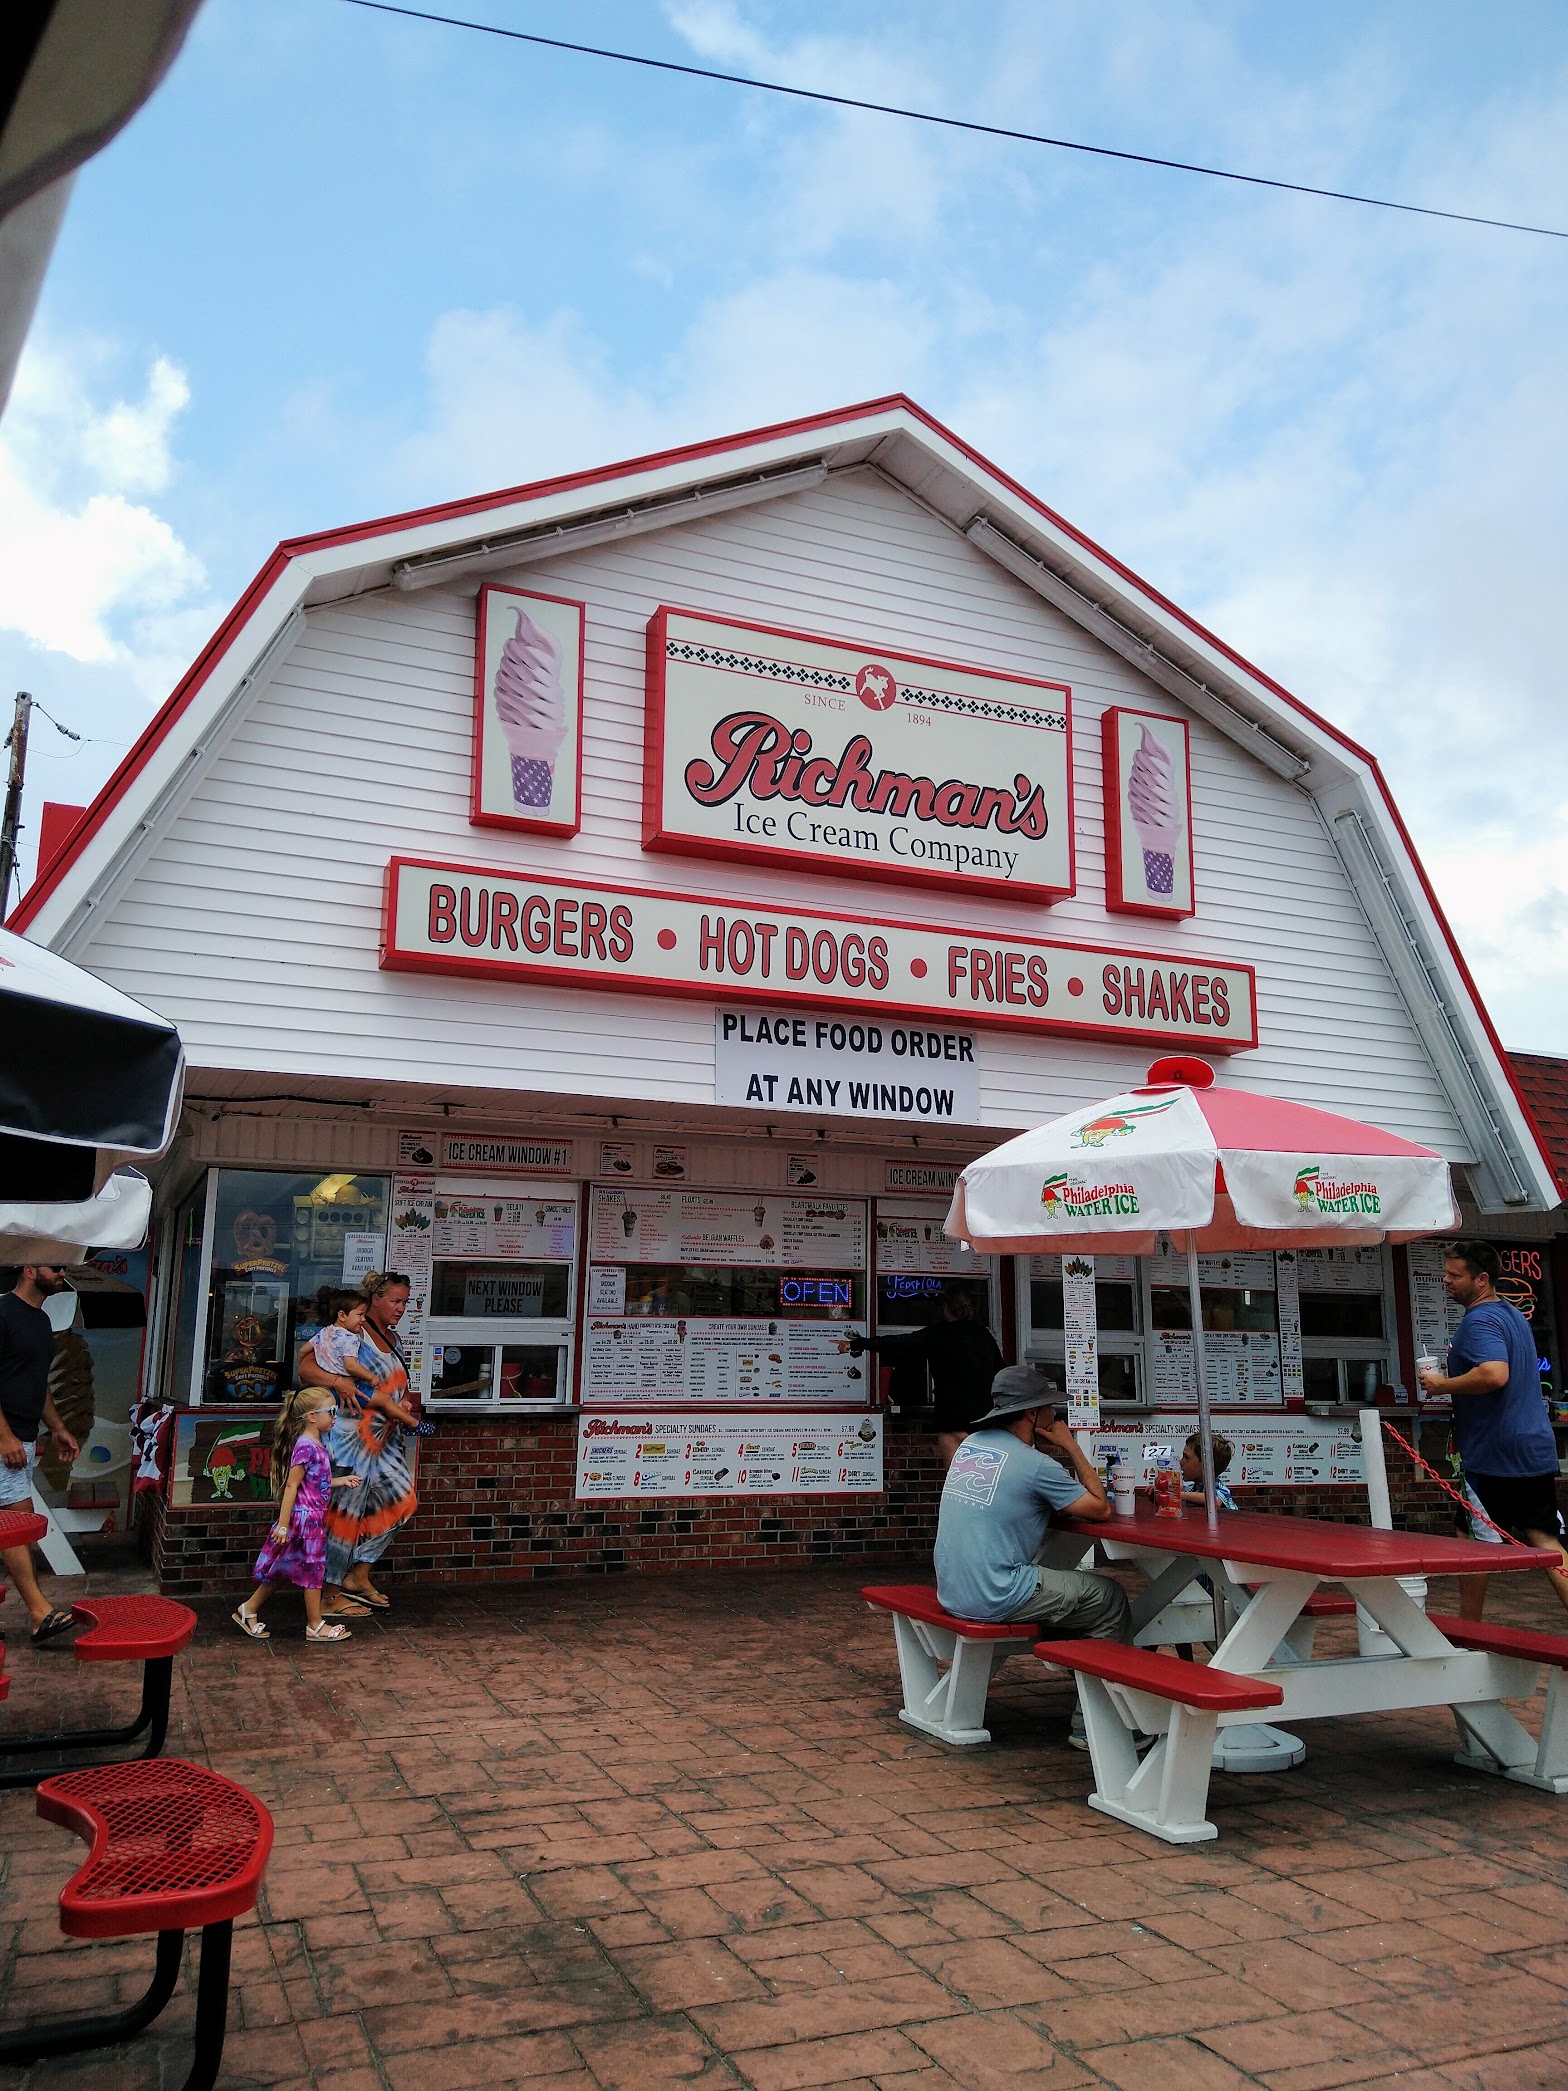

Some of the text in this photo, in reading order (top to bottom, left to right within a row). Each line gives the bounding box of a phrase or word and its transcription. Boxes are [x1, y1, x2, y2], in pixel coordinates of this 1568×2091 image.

[804, 694, 846, 711] SINCE
[907, 712, 932, 727] 1894
[685, 711, 1048, 841] Richman's
[733, 803, 1019, 879] Ice Cream Company
[428, 883, 1231, 1028] BURGERS HOT DOGS FRIES SHAKES
[722, 1013, 976, 1063] PLACE FOOD ORDER
[745, 1073, 955, 1117] AT ANY WINDOW
[449, 1142, 568, 1166] ICE CREAM WINDOW #1
[890, 1168, 904, 1185] ICE
[906, 1169, 937, 1187] CREAM
[1062, 1183, 1135, 1205] Philadelphia
[1315, 1181, 1378, 1200] Philadelphia
[506, 1203, 524, 1211] GELATI
[598, 1195, 621, 1203] SHAKES
[681, 1195, 702, 1204] FLOATS
[791, 1200, 849, 1211] BOARDWALK FAVORITES
[1064, 1194, 1140, 1218] WATER ICE
[1316, 1193, 1381, 1213] WATER ICE
[545, 1205, 572, 1214] SMOOTHIES
[701, 1234, 723, 1243] BELGIAN
[723, 1236, 745, 1244] WAFFLES
[234, 1259, 286, 1273] SUPERPRETZEL
[355, 1255, 374, 1263] SEATING
[1501, 1250, 1542, 1281] GERS
[351, 1265, 375, 1273] AVAILABLE
[468, 1281, 543, 1297] NEXT WINDOW
[783, 1280, 849, 1304] OPEN
[484, 1298, 523, 1314] PLEASE
[590, 1321, 627, 1331] Richman's
[627, 1322, 639, 1330] HAND
[224, 1366, 278, 1380] SUPERPRETZEL
[582, 1418, 653, 1438] Richman's
[655, 1424, 688, 1434] SPECIALTY
[688, 1424, 717, 1434] SUNDAES
[841, 1425, 855, 1433] $7.99
[1144, 1424, 1174, 1434] SPECIALTY
[1174, 1424, 1200, 1434] SUNDAES
[1337, 1427, 1350, 1435] $7.99
[635, 1443, 643, 1460] 2
[684, 1443, 692, 1460] 3
[738, 1443, 746, 1458] 4
[791, 1442, 798, 1457] 5
[837, 1442, 844, 1458] 6
[1147, 1447, 1168, 1458] 27
[1241, 1443, 1246, 1457] 7
[1286, 1445, 1292, 1458] 9
[582, 1472, 589, 1489] 7
[633, 1470, 641, 1487] 8
[684, 1470, 692, 1487] 9
[737, 1469, 747, 1485] 10
[791, 1466, 800, 1483] 11
[837, 1468, 848, 1483] 12
[1241, 1466, 1247, 1481] 8
[1284, 1466, 1293, 1480] 10
[1329, 1466, 1338, 1479] 12
